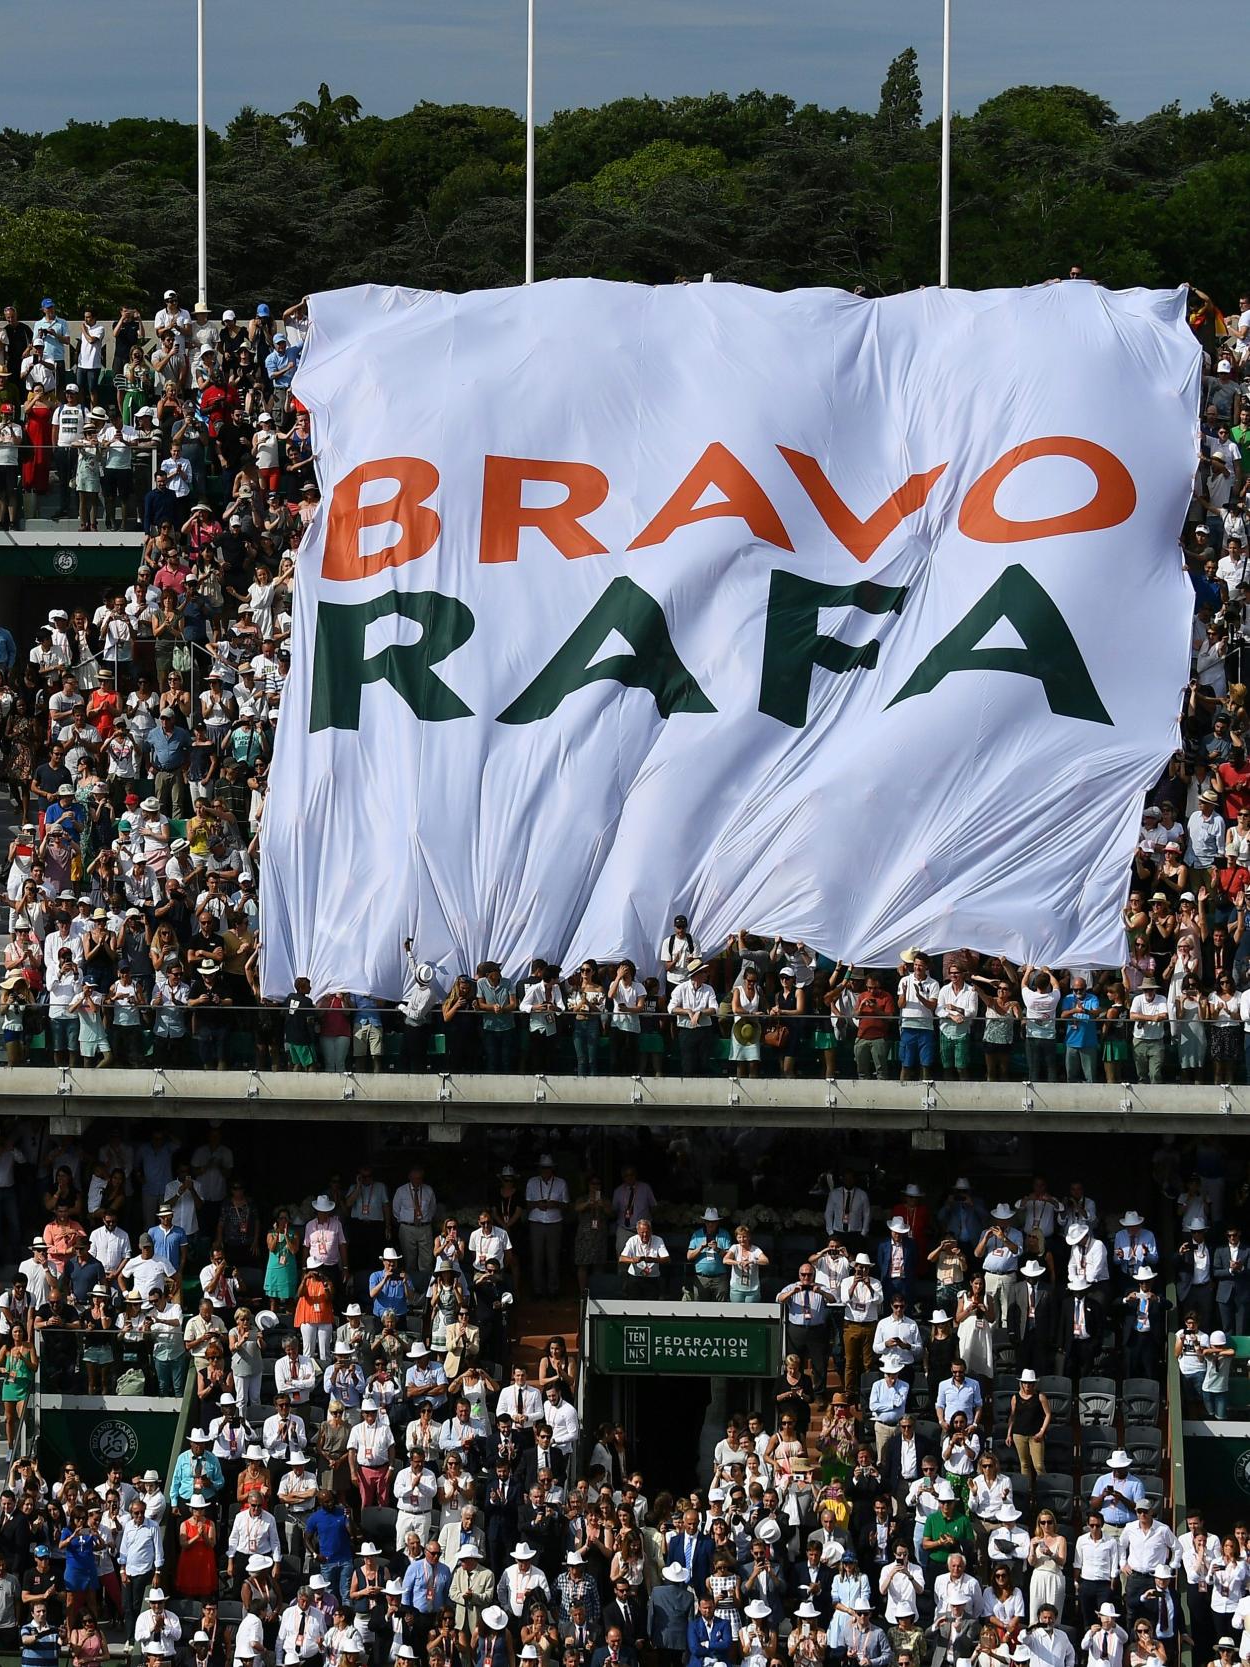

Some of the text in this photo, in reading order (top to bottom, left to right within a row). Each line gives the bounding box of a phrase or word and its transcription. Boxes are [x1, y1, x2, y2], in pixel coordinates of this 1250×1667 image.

[320, 435, 1138, 582] BRAVO
[308, 563, 1116, 734] RAFA
[629, 1332, 646, 1343] TEN
[655, 1336, 748, 1347] FÉDÉRATION
[629, 1348, 646, 1359] NIS
[655, 1347, 748, 1358] FRANÇAISE
[115, 1422, 136, 1450] GARROS
